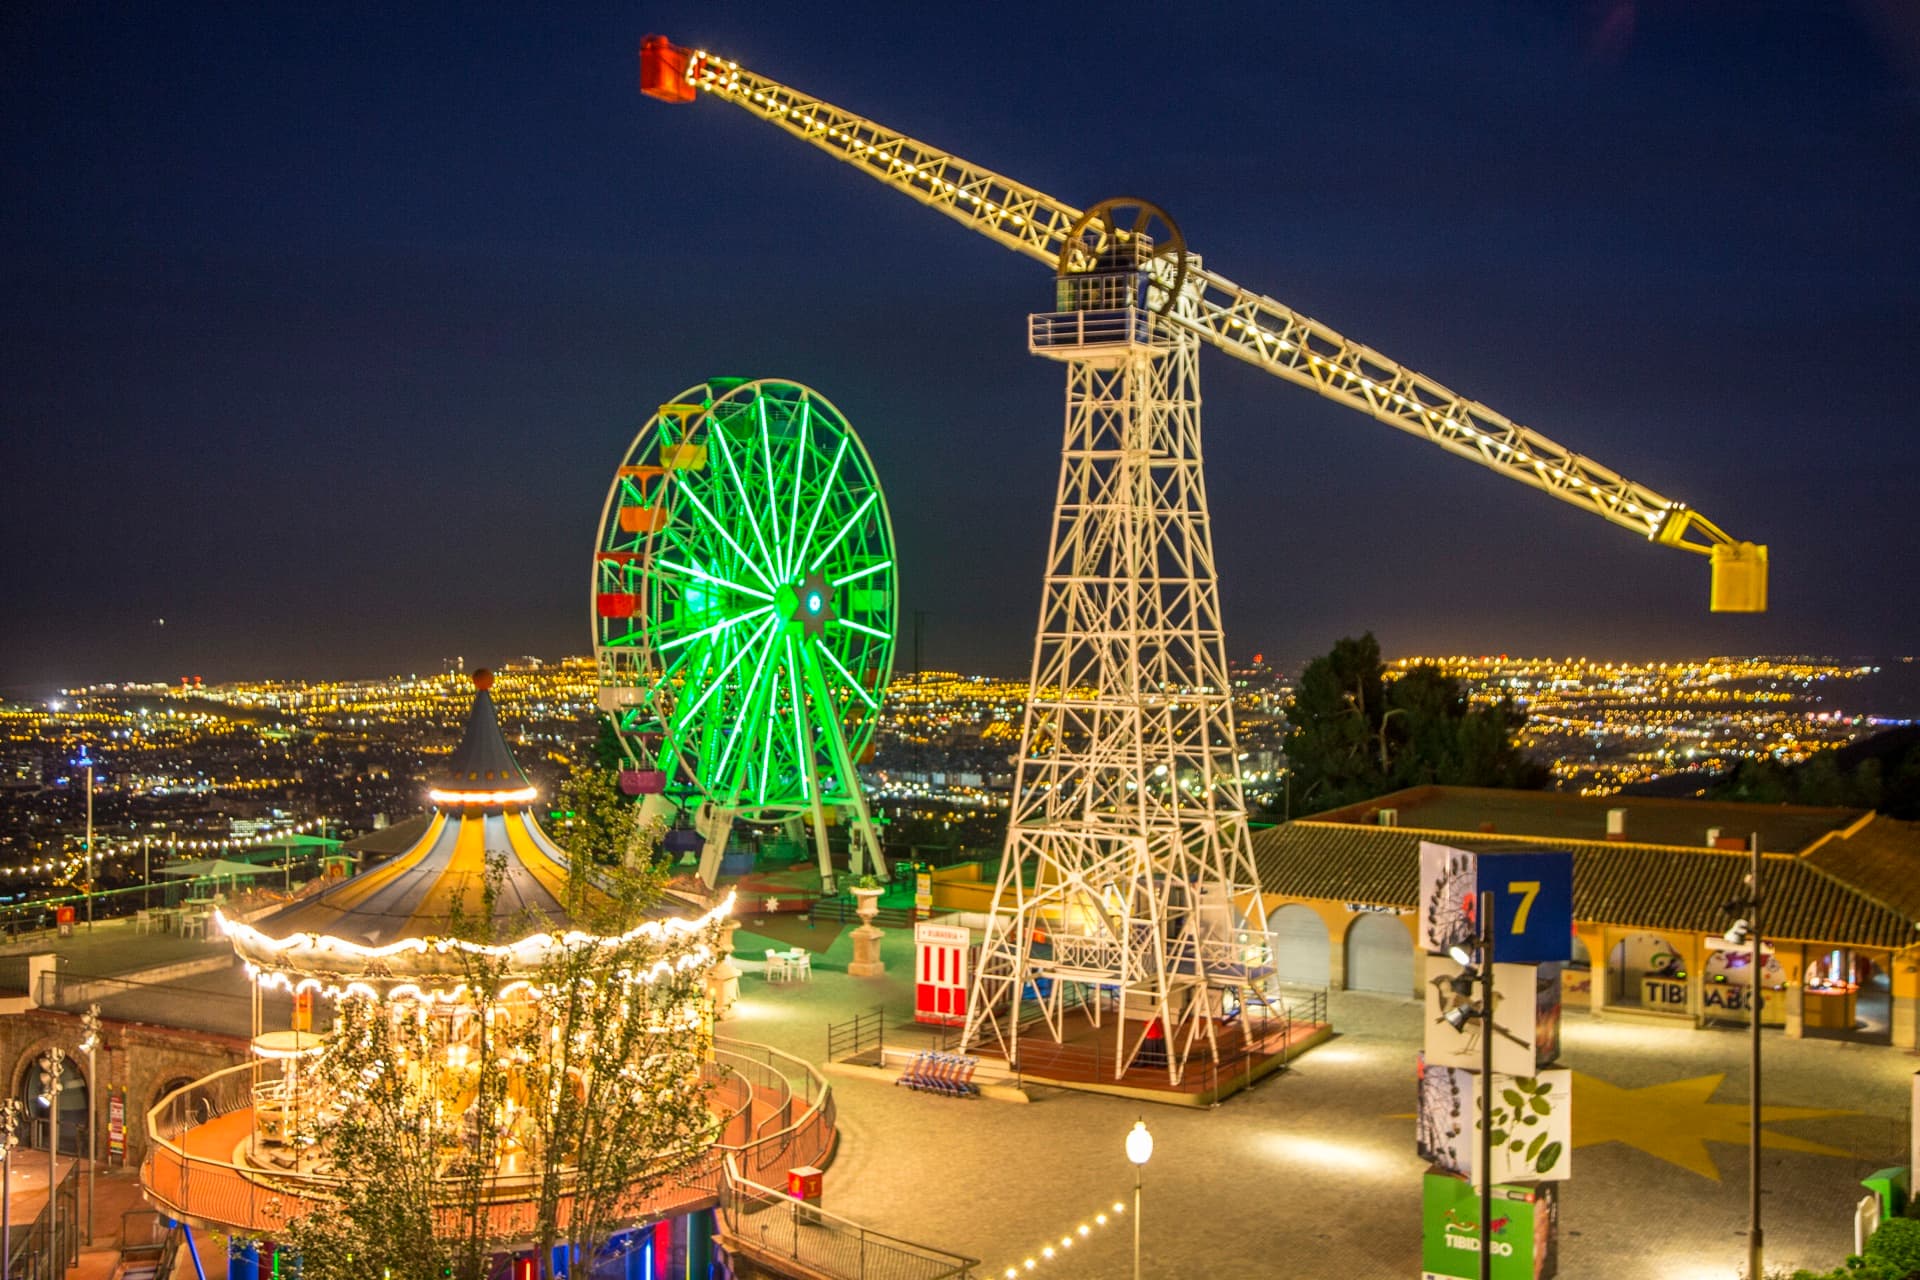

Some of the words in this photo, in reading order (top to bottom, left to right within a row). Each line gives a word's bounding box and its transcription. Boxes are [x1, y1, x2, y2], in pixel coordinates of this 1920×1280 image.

[1508, 881, 1540, 935] 7
[1646, 982, 1765, 1010] TIBABO
[1444, 1233, 1513, 1257] TIBIDBO
